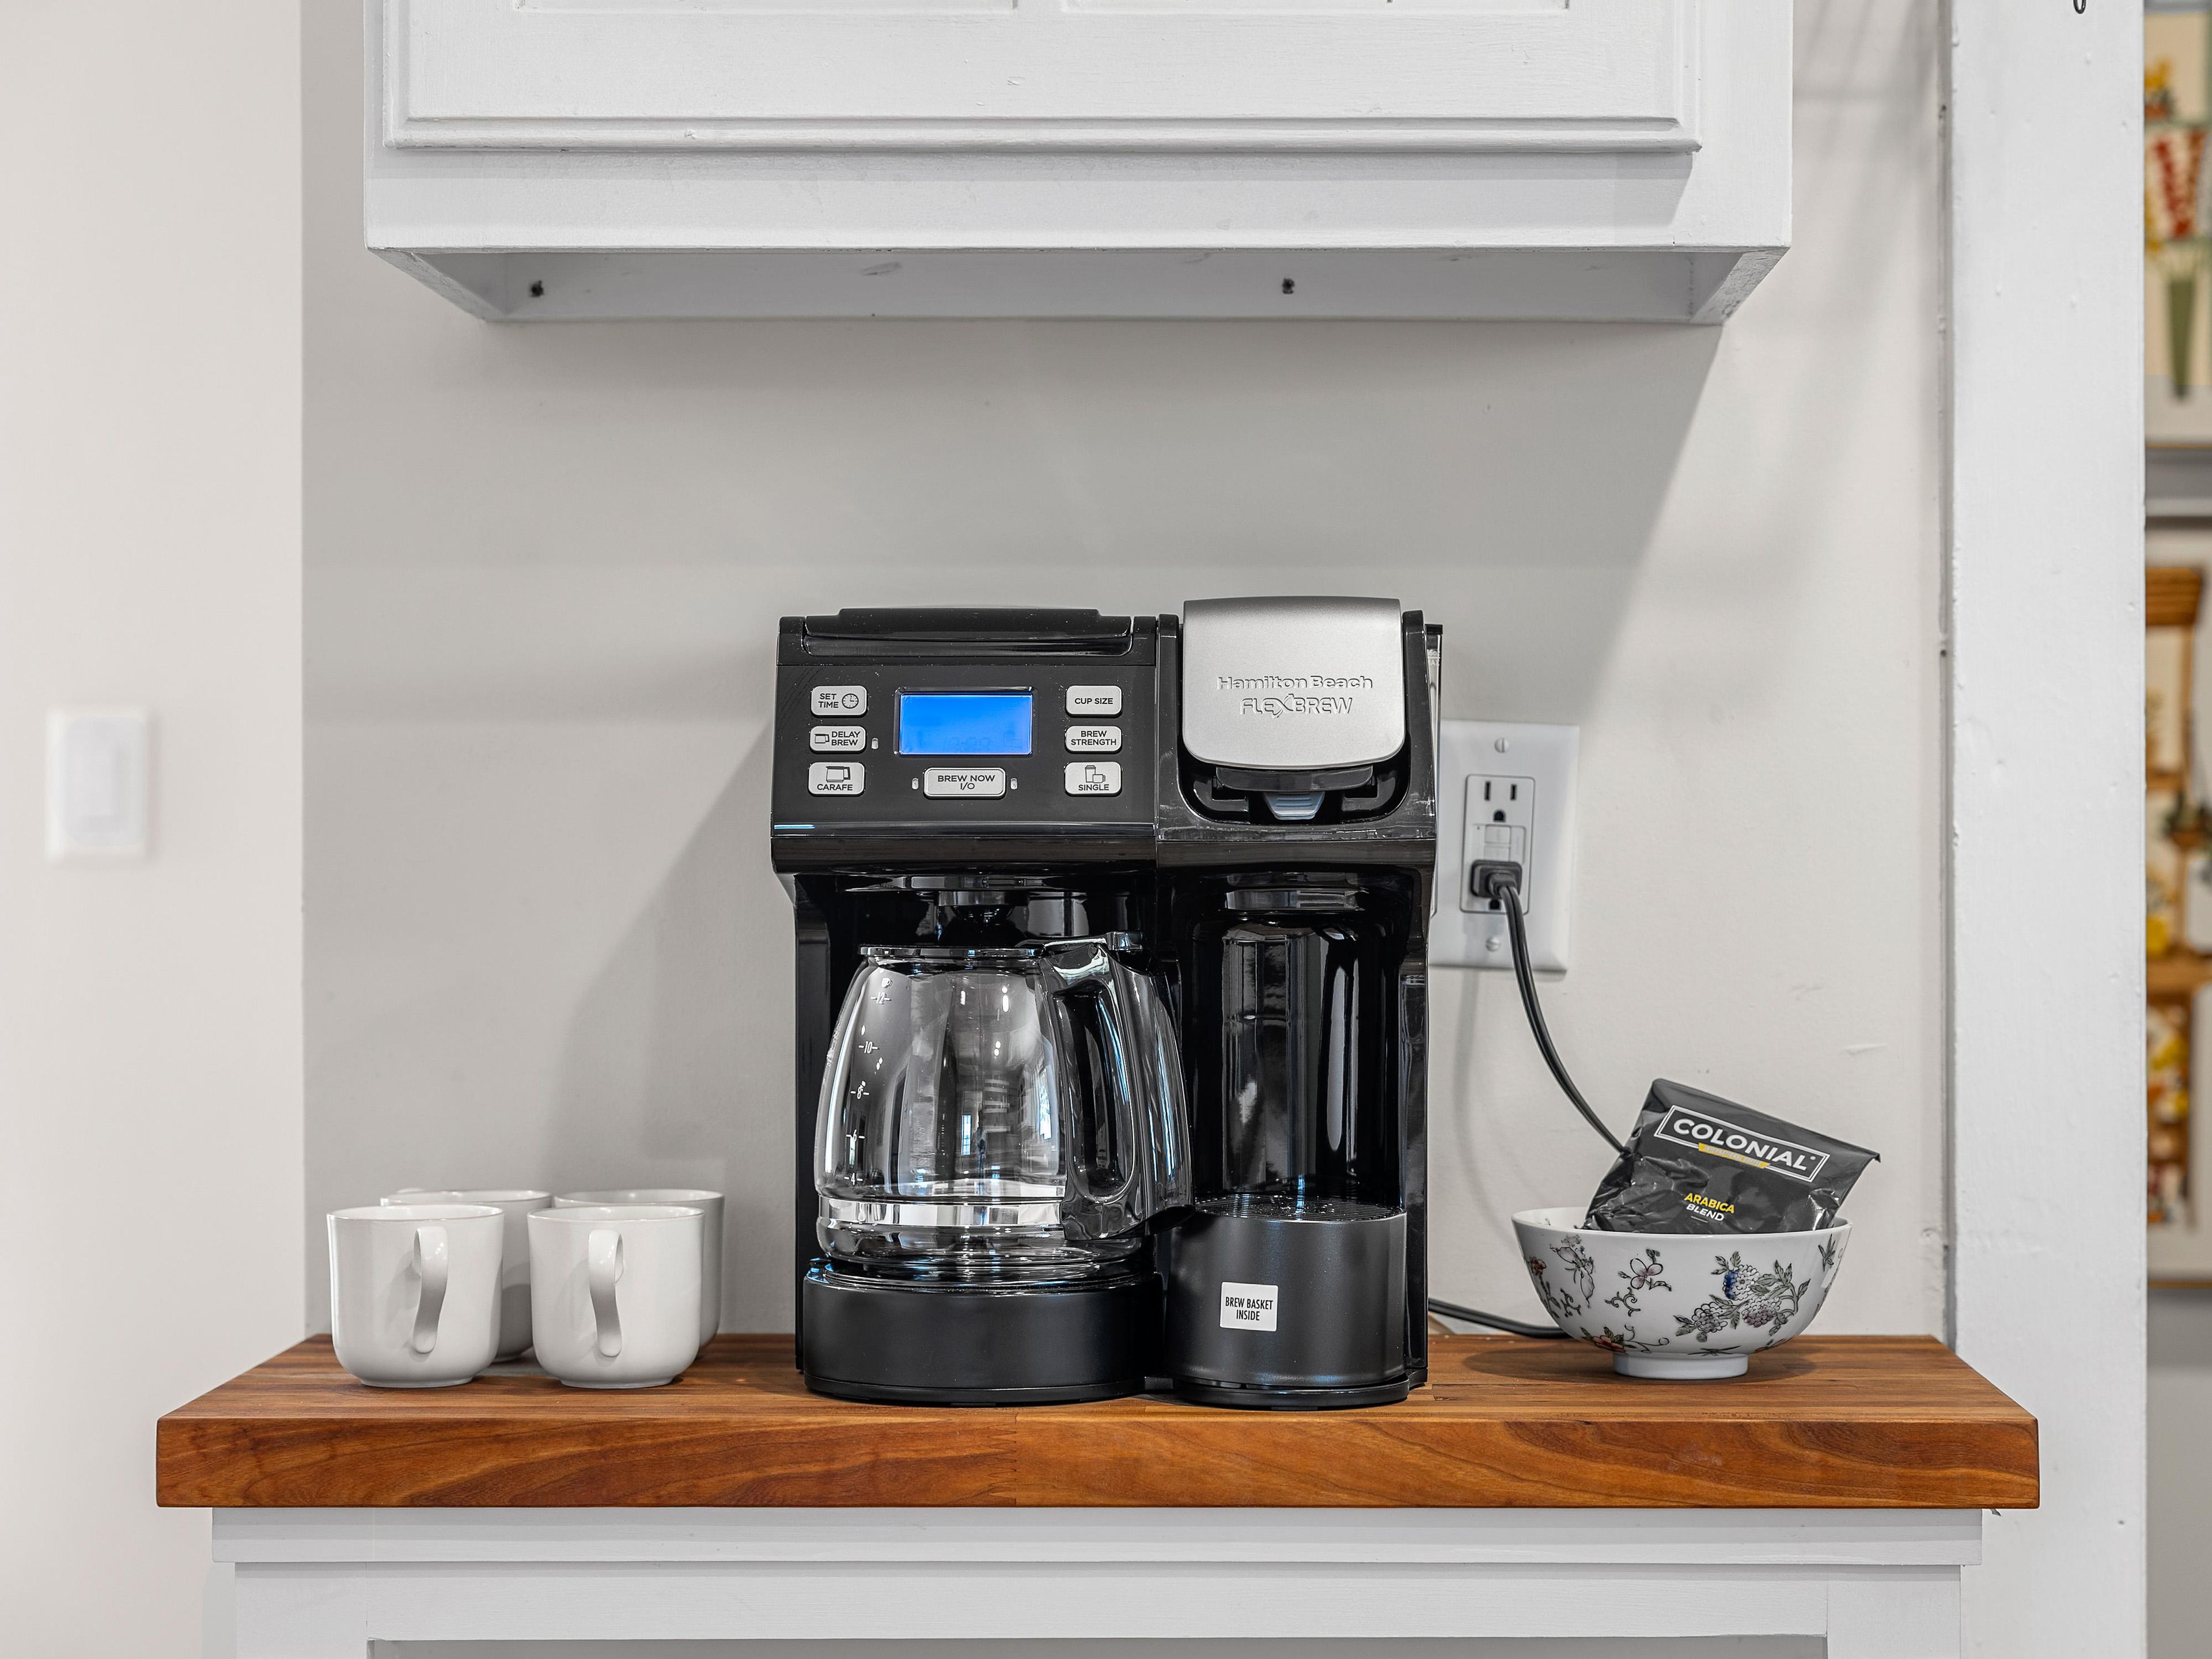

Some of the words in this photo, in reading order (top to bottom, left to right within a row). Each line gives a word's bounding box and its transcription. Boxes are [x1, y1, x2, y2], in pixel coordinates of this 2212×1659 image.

[1217, 676, 1308, 690] Hamilton
[1310, 676, 1373, 689] Beach
[960, 782, 976, 790] I/O
[864, 1041, 873, 1054] 10
[1673, 1118, 1808, 1171] COLONIAL
[851, 1172, 855, 1185] 4
[1684, 1192, 1735, 1214] ARABICA
[1685, 1203, 1725, 1222] BLEND
[1225, 1296, 1245, 1308] BREW
[1247, 1298, 1274, 1310] BASKET
[1236, 1309, 1260, 1321] INSIDE
